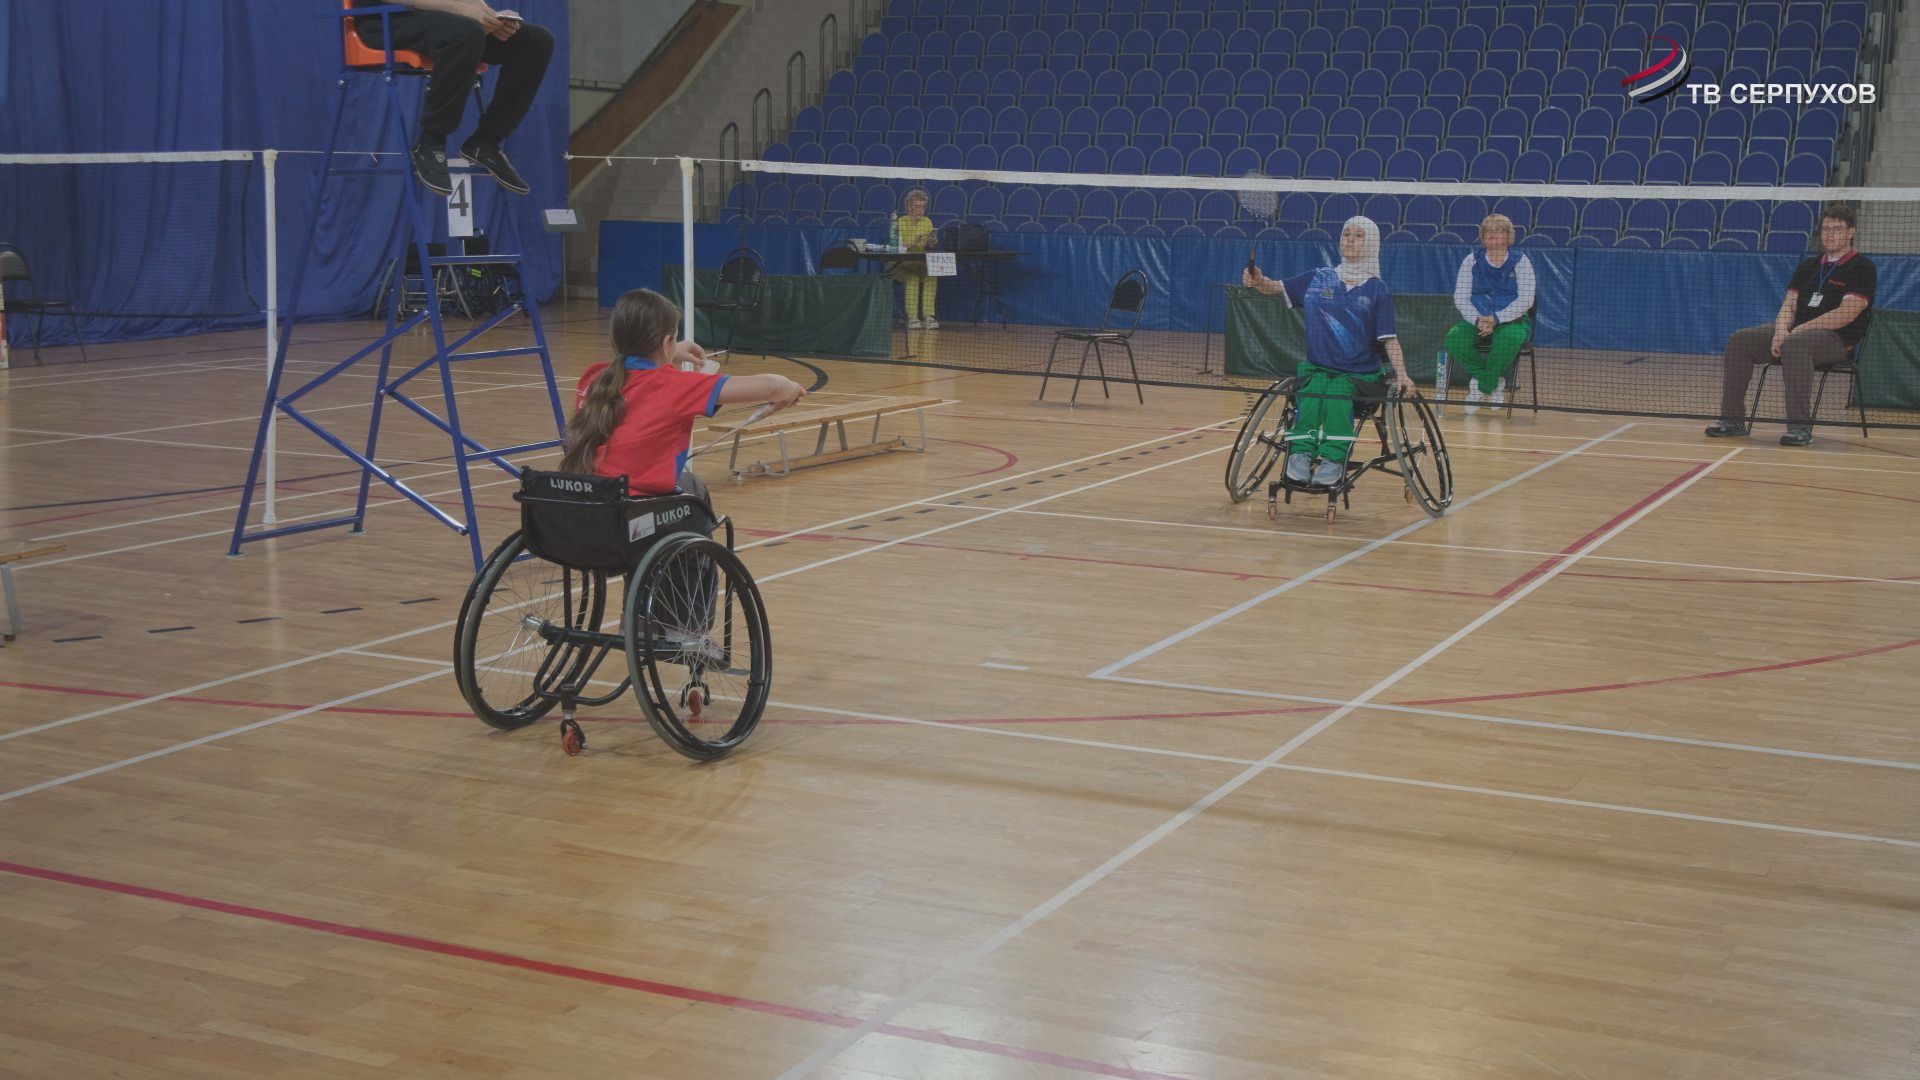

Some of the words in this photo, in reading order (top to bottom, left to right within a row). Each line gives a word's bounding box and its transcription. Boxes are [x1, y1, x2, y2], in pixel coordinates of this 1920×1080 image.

[448, 179, 470, 217] 4
[550, 477, 593, 493] LUKOR
[656, 505, 691, 526] LUKOR
